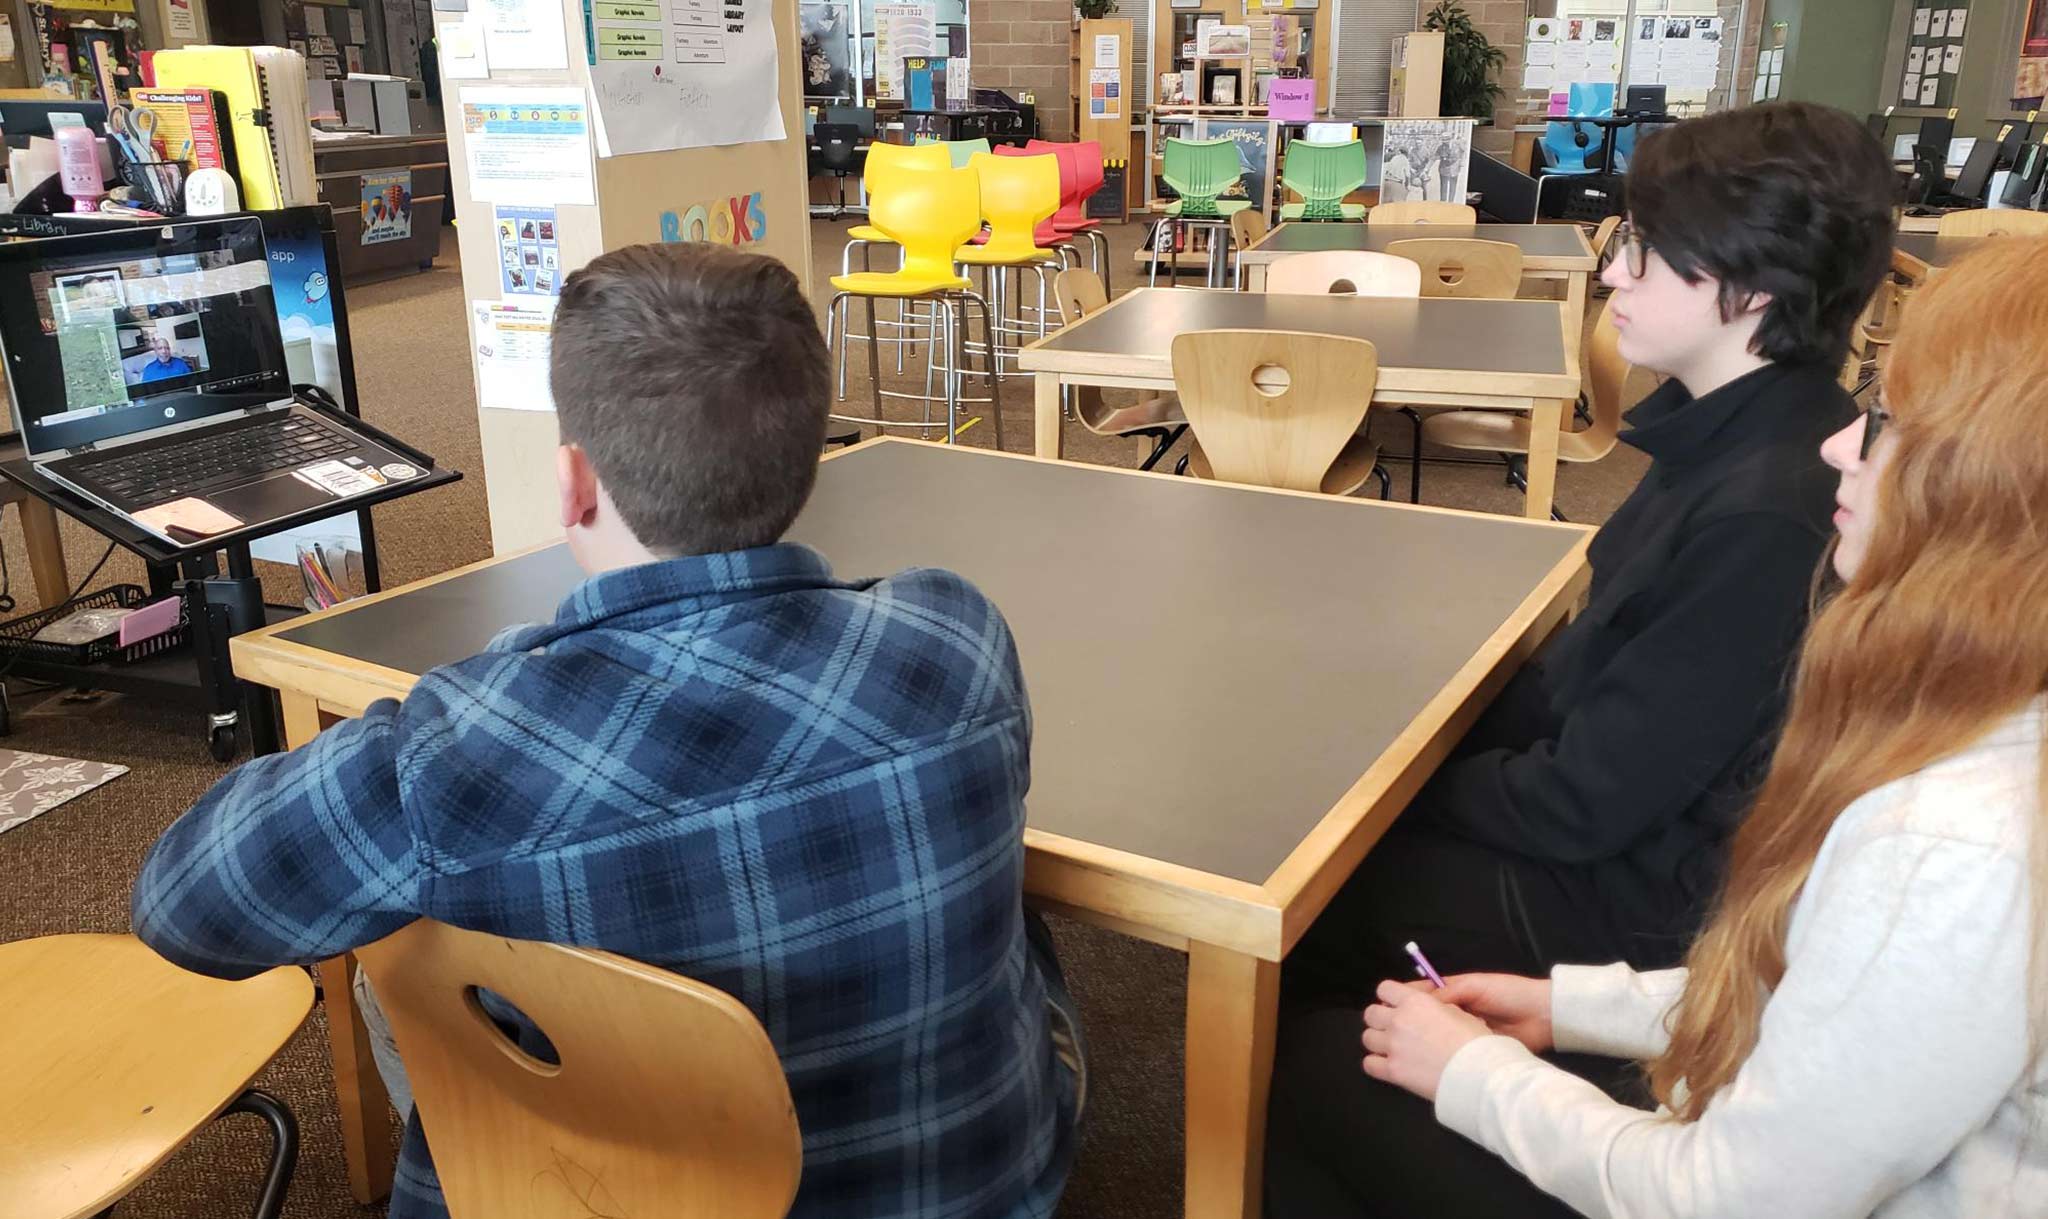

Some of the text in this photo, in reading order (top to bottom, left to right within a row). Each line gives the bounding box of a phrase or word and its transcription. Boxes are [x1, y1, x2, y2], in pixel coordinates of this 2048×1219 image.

[724, 10, 744, 20] LIBRARY
[727, 24, 744, 33] LAYOUT
[907, 58, 926, 70] HELP
[1274, 92, 1302, 101] Window
[661, 192, 765, 244] BOOKS
[23, 217, 67, 236] Library
[271, 251, 295, 263] app
